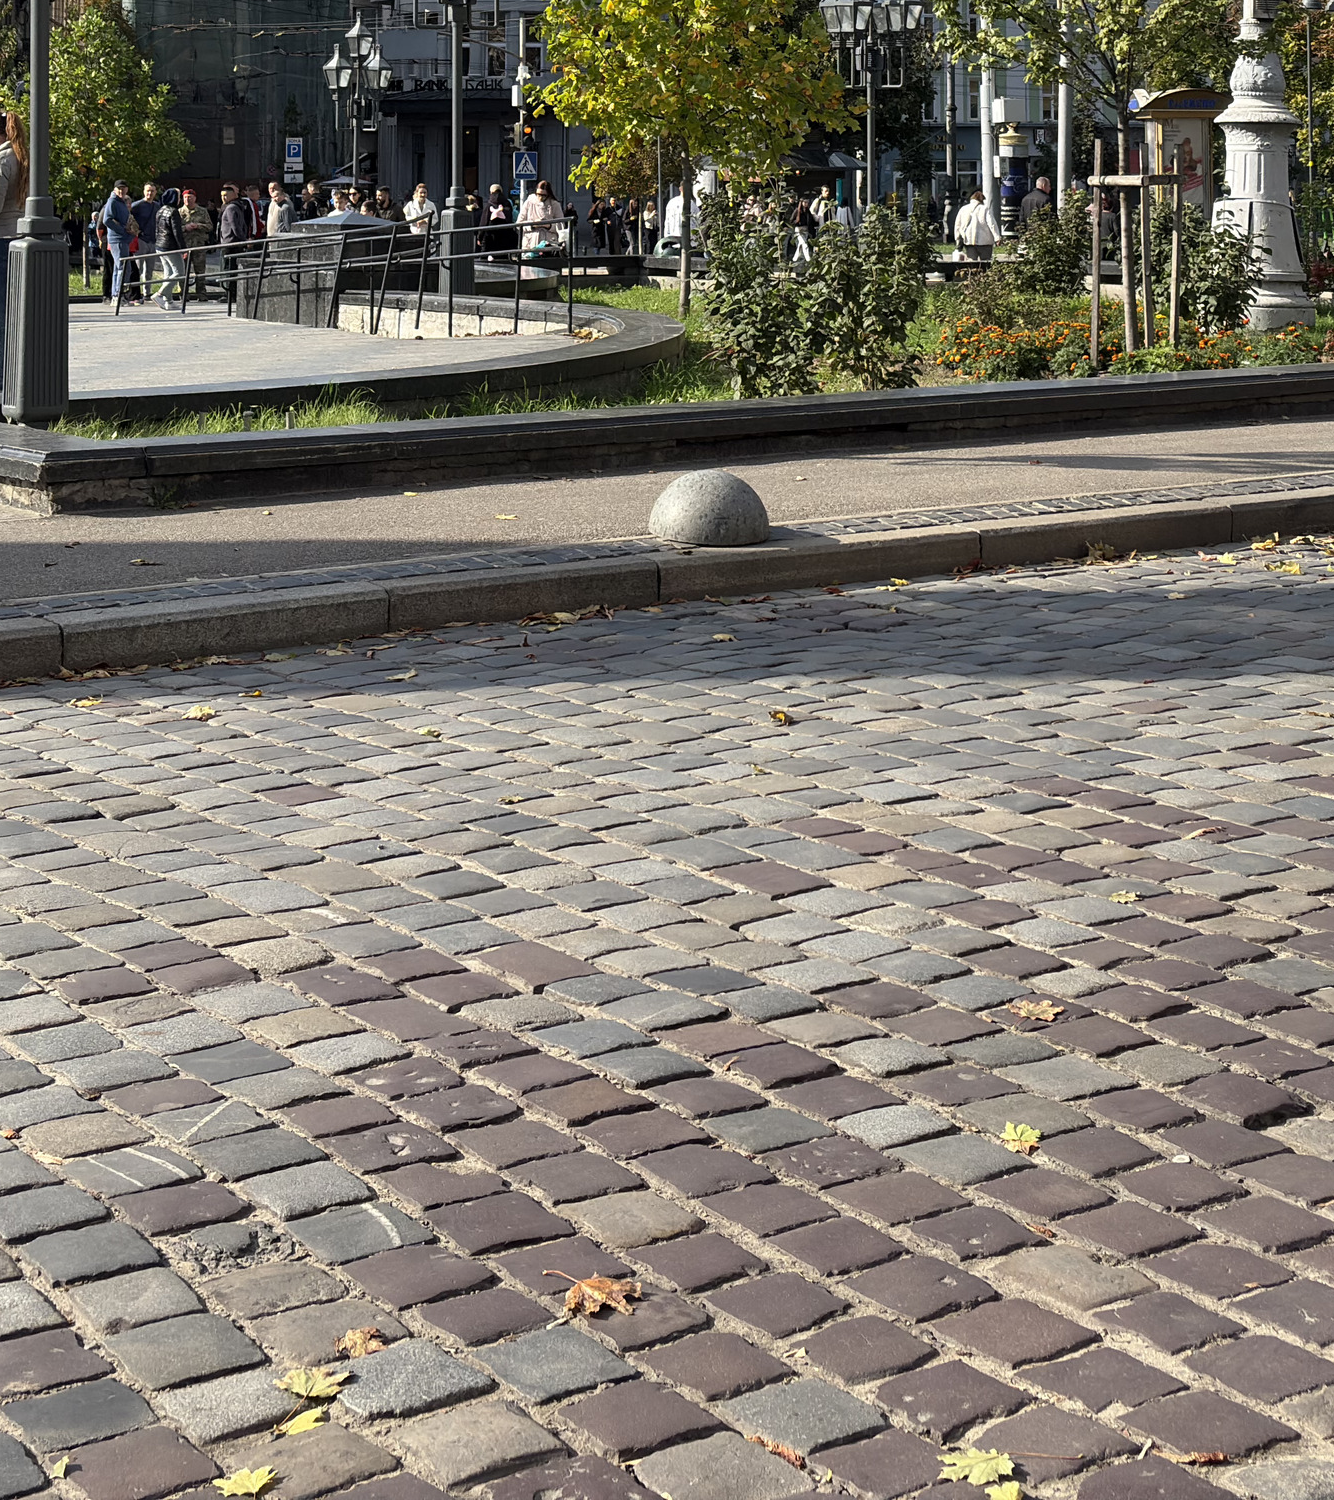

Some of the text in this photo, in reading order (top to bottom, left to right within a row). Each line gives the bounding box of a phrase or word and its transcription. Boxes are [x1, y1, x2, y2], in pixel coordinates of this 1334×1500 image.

[414, 79, 448, 90] BANK
[465, 79, 503, 90] БАНК
[290, 145, 298, 156] P
